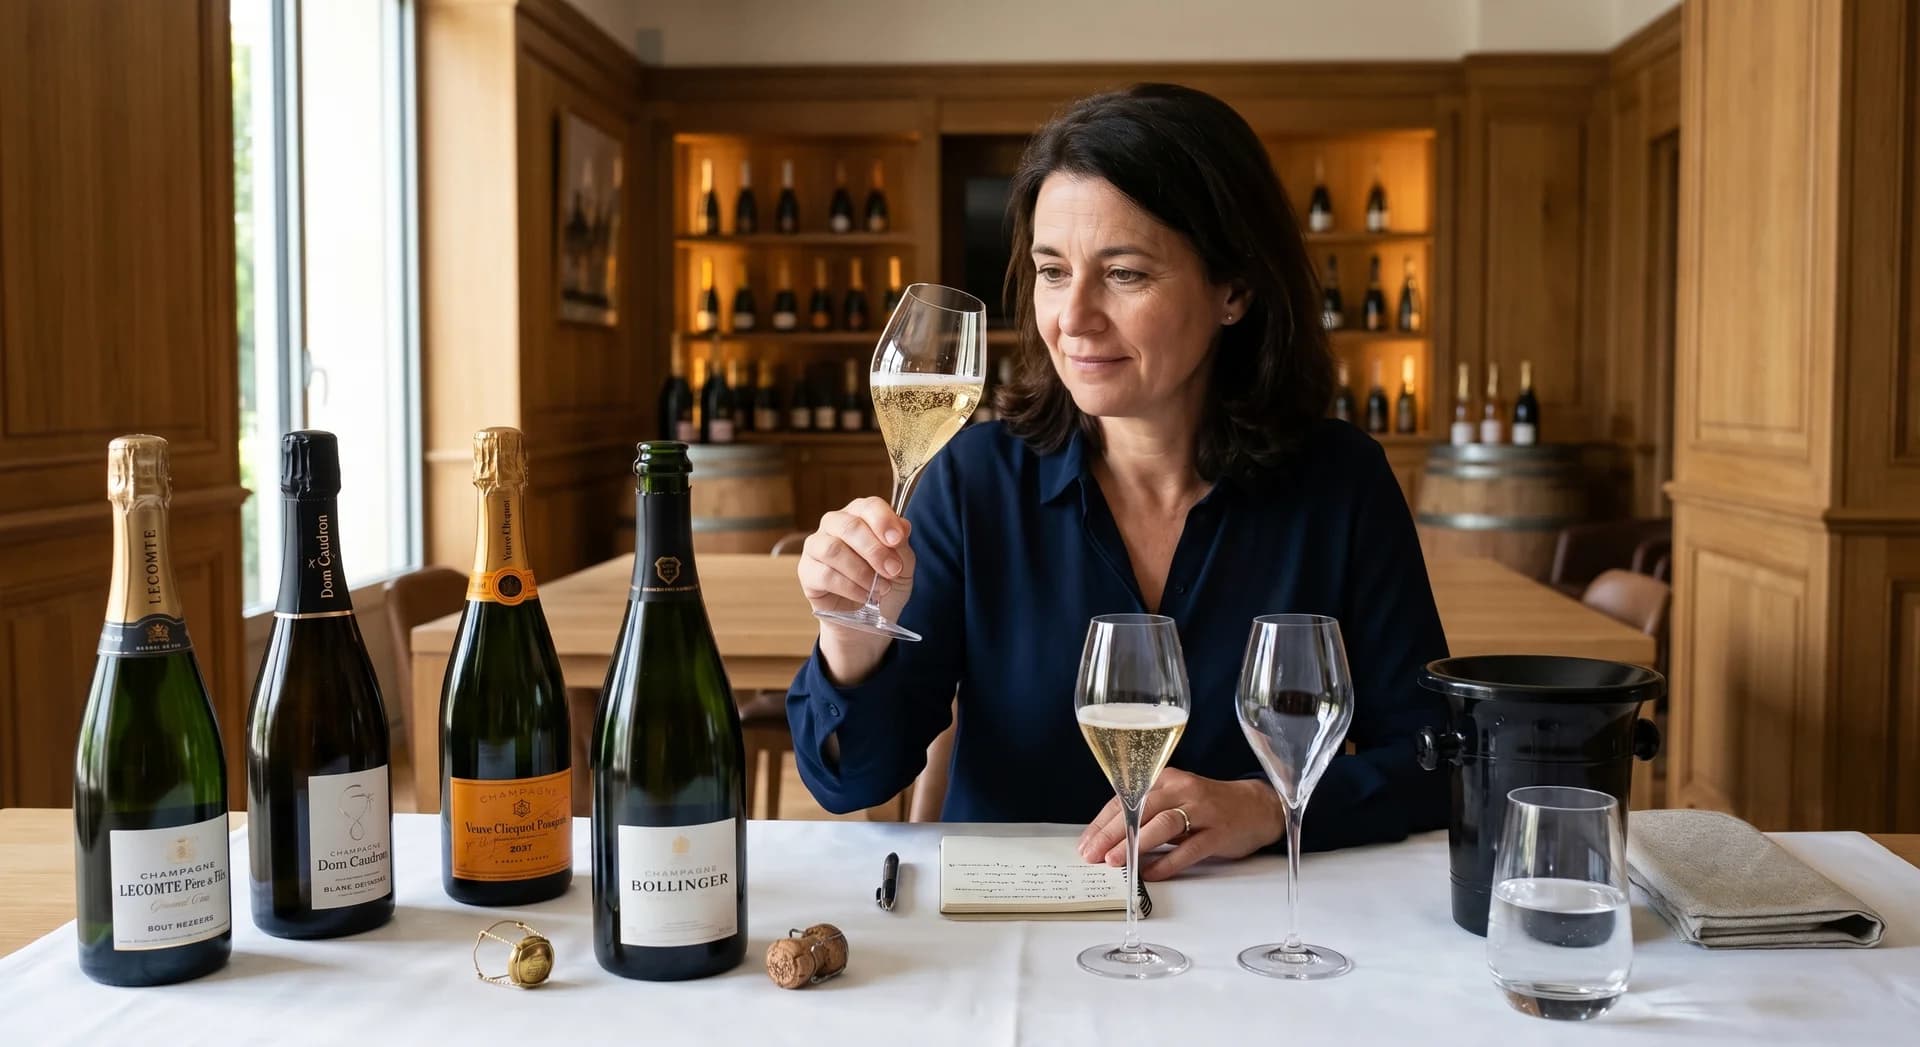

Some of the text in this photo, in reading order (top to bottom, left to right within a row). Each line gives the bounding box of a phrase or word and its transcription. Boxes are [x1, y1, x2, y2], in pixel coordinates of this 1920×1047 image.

[316, 514, 334, 598] Dom Caudron
[144, 529, 161, 605] LECOMTE
[465, 821, 492, 835] Veuve
[494, 820, 535, 837] Clicquot
[140, 861, 216, 880] CHAMPAGNE
[318, 859, 347, 872] Dom
[645, 864, 718, 878] CHAMPAGNE
[119, 880, 182, 897] LECOMTE
[185, 874, 206, 891] Père
[207, 876, 214, 886] &
[631, 873, 729, 893] BOLLINGER
[147, 923, 173, 933] BOUT
